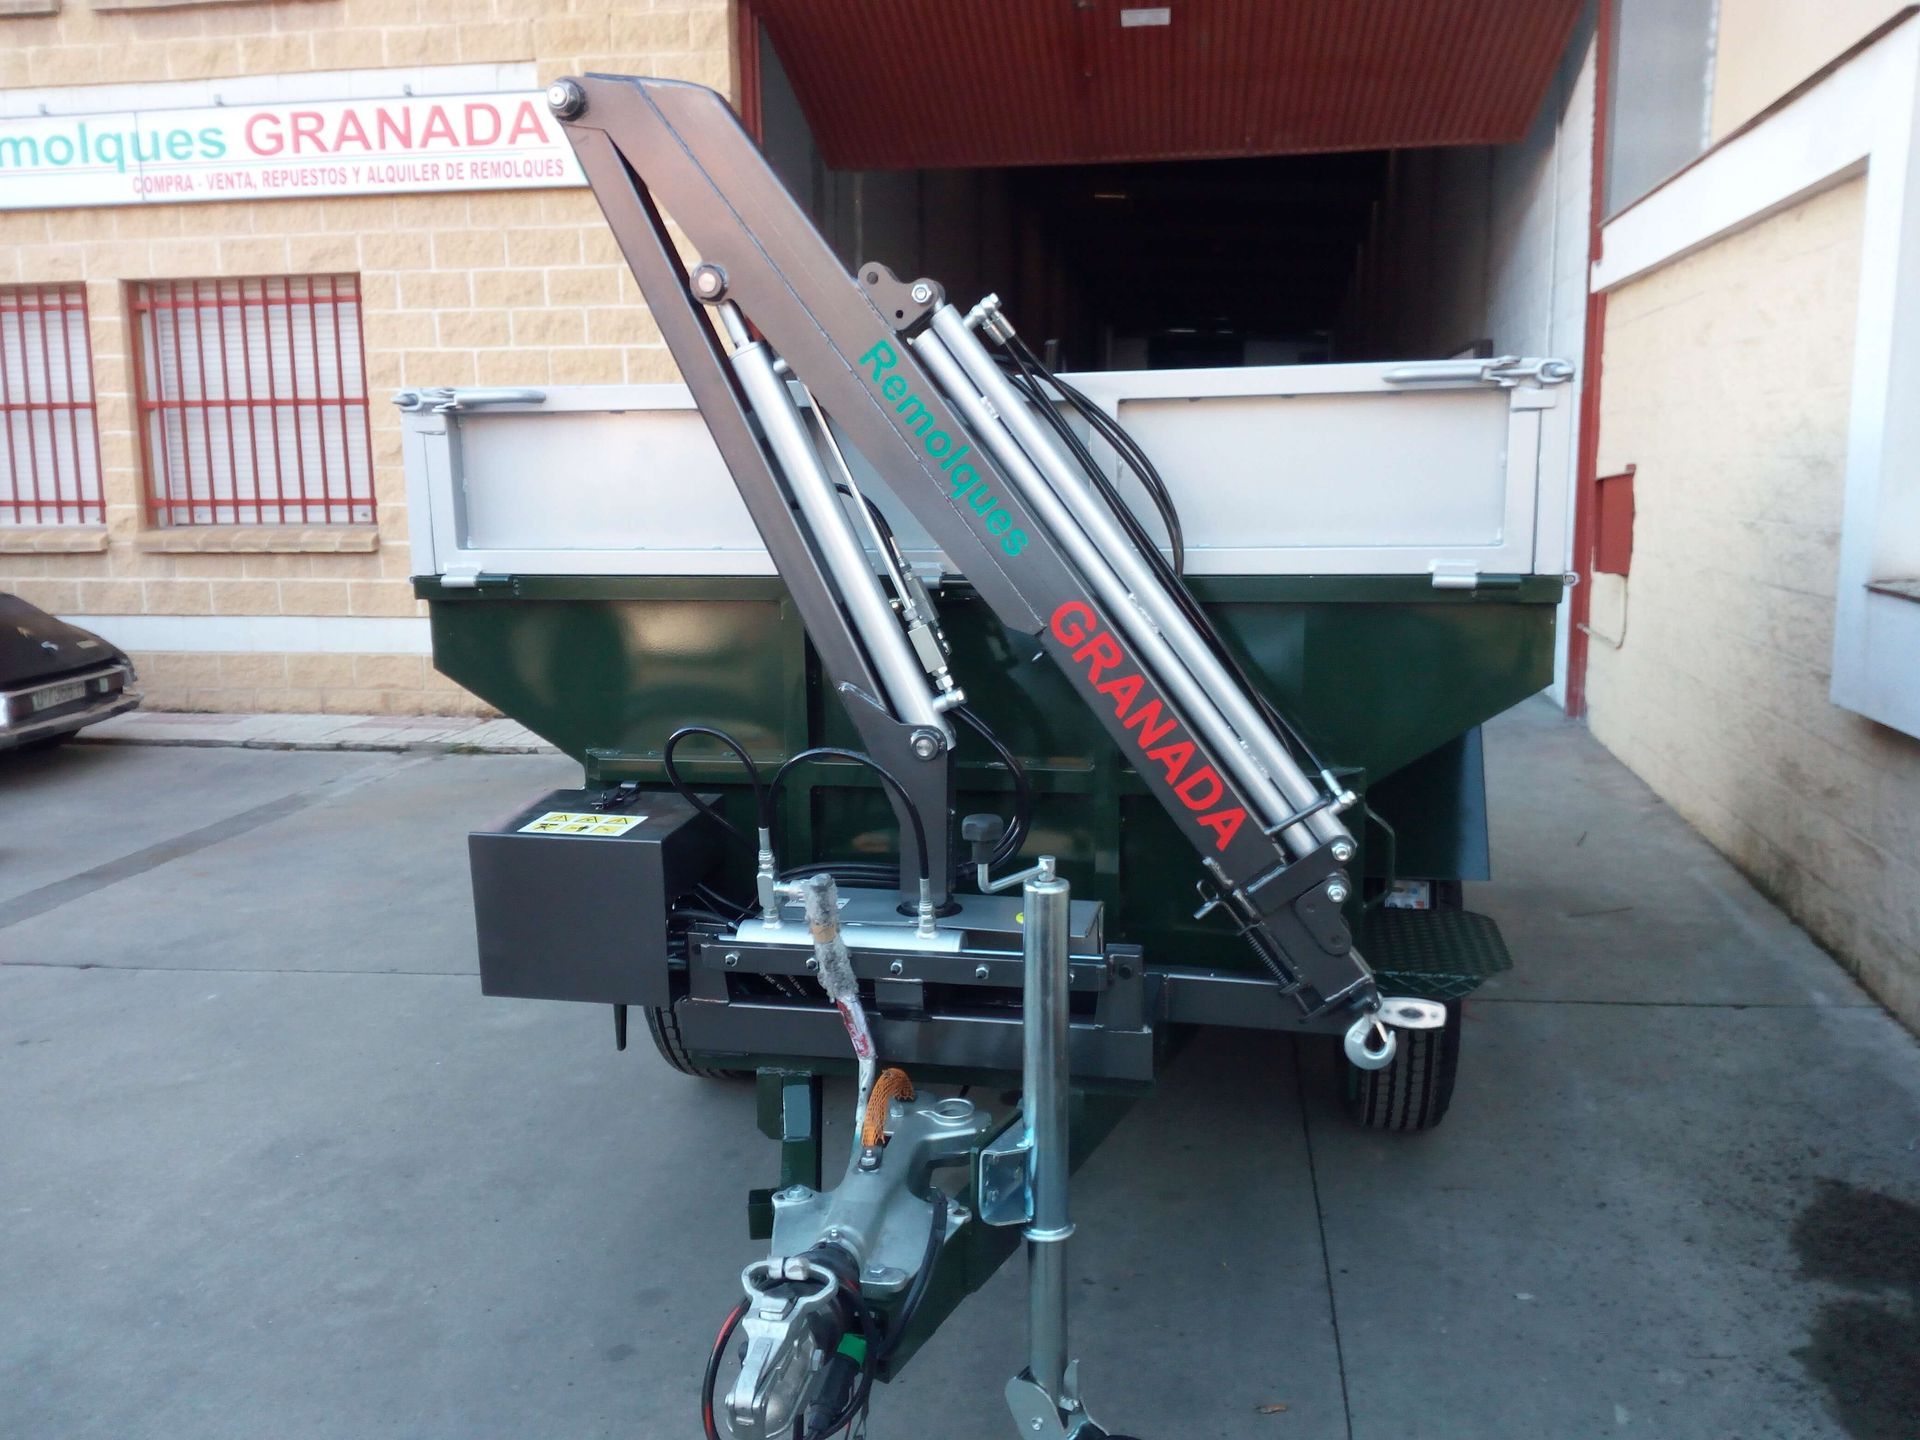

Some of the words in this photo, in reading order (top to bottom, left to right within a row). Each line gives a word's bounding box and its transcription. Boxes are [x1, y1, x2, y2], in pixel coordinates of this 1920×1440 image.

[133, 173, 194, 194] COMPRA
[206, 171, 257, 191] VENTA,
[262, 167, 347, 188] REPUESTOS
[352, 166, 361, 184] Y
[367, 163, 440, 183] ALQUILER
[446, 162, 465, 180] DE
[470, 158, 564, 179] REMOLQUES
[245, 101, 550, 156] GRANADA
[858, 339, 1029, 558] Remolques
[1050, 600, 1247, 852] GRANADA
